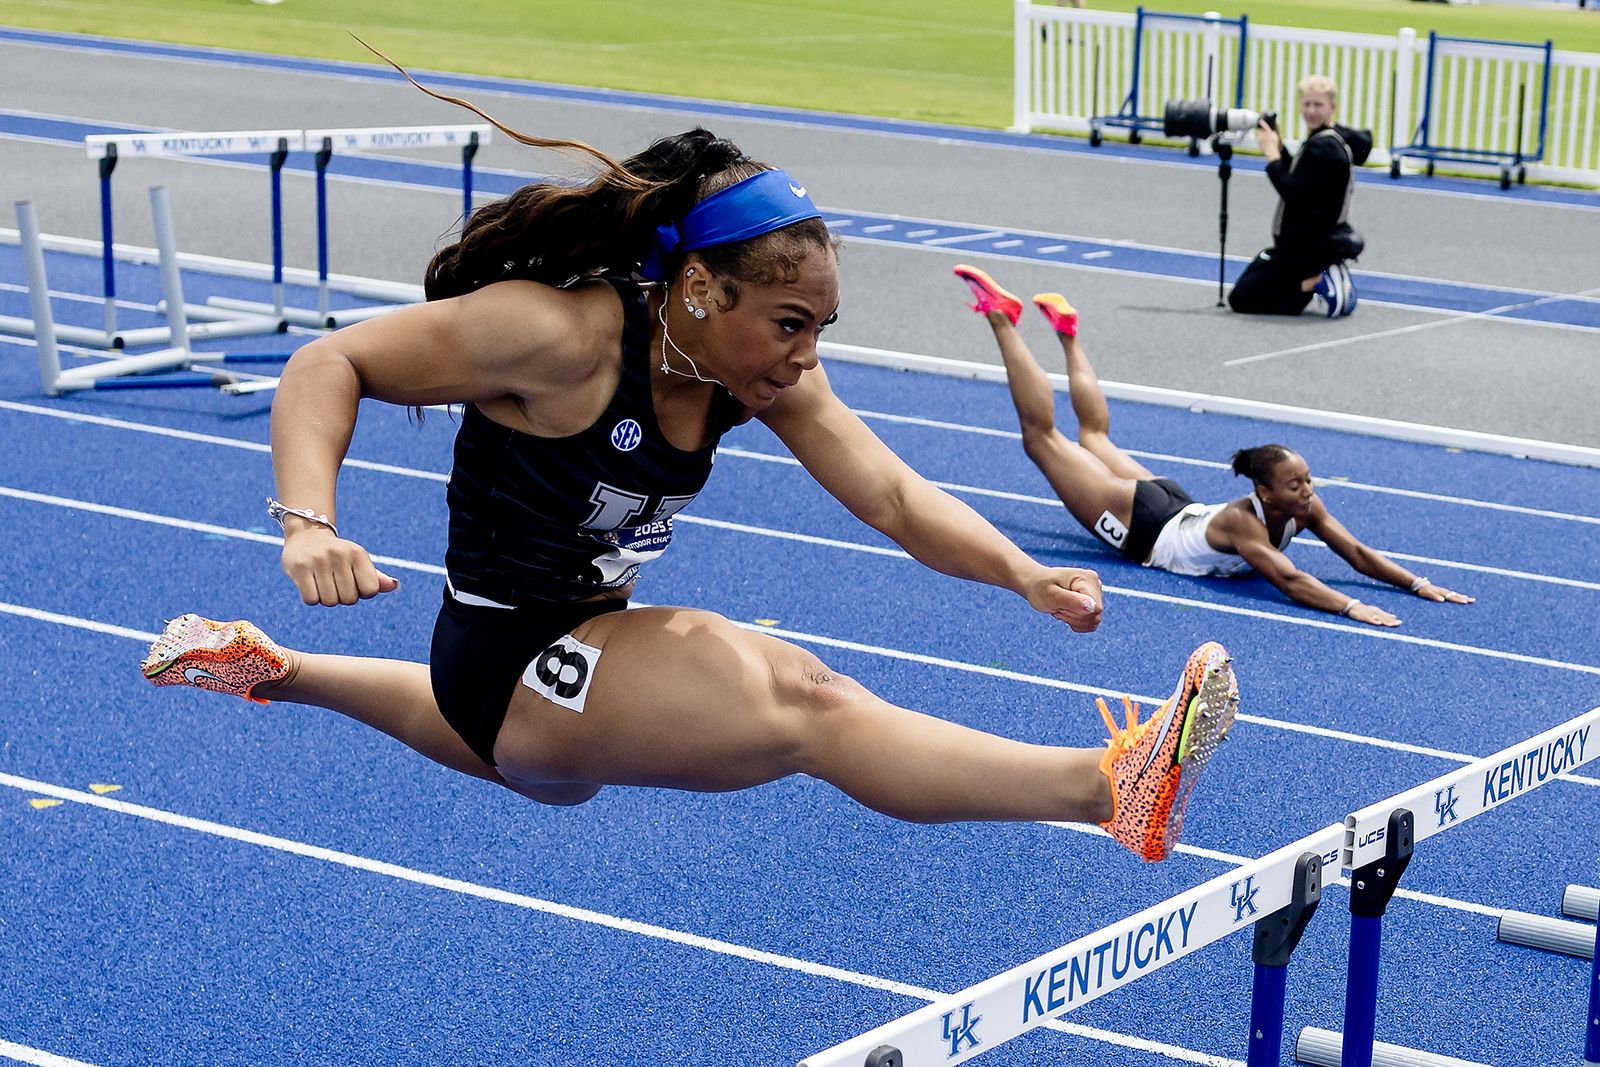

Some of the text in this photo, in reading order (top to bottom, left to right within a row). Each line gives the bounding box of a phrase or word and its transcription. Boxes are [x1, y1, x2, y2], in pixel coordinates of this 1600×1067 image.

[162, 137, 234, 151] KENTUCKY
[612, 420, 641, 450] SEC
[634, 521, 666, 537] 2025
[1100, 517, 1123, 541] 3
[535, 644, 588, 699] 8
[1358, 725, 1591, 848] UCS UK KENTUCKY
[940, 849, 1339, 1059] UK KENTUCKY UK CS
